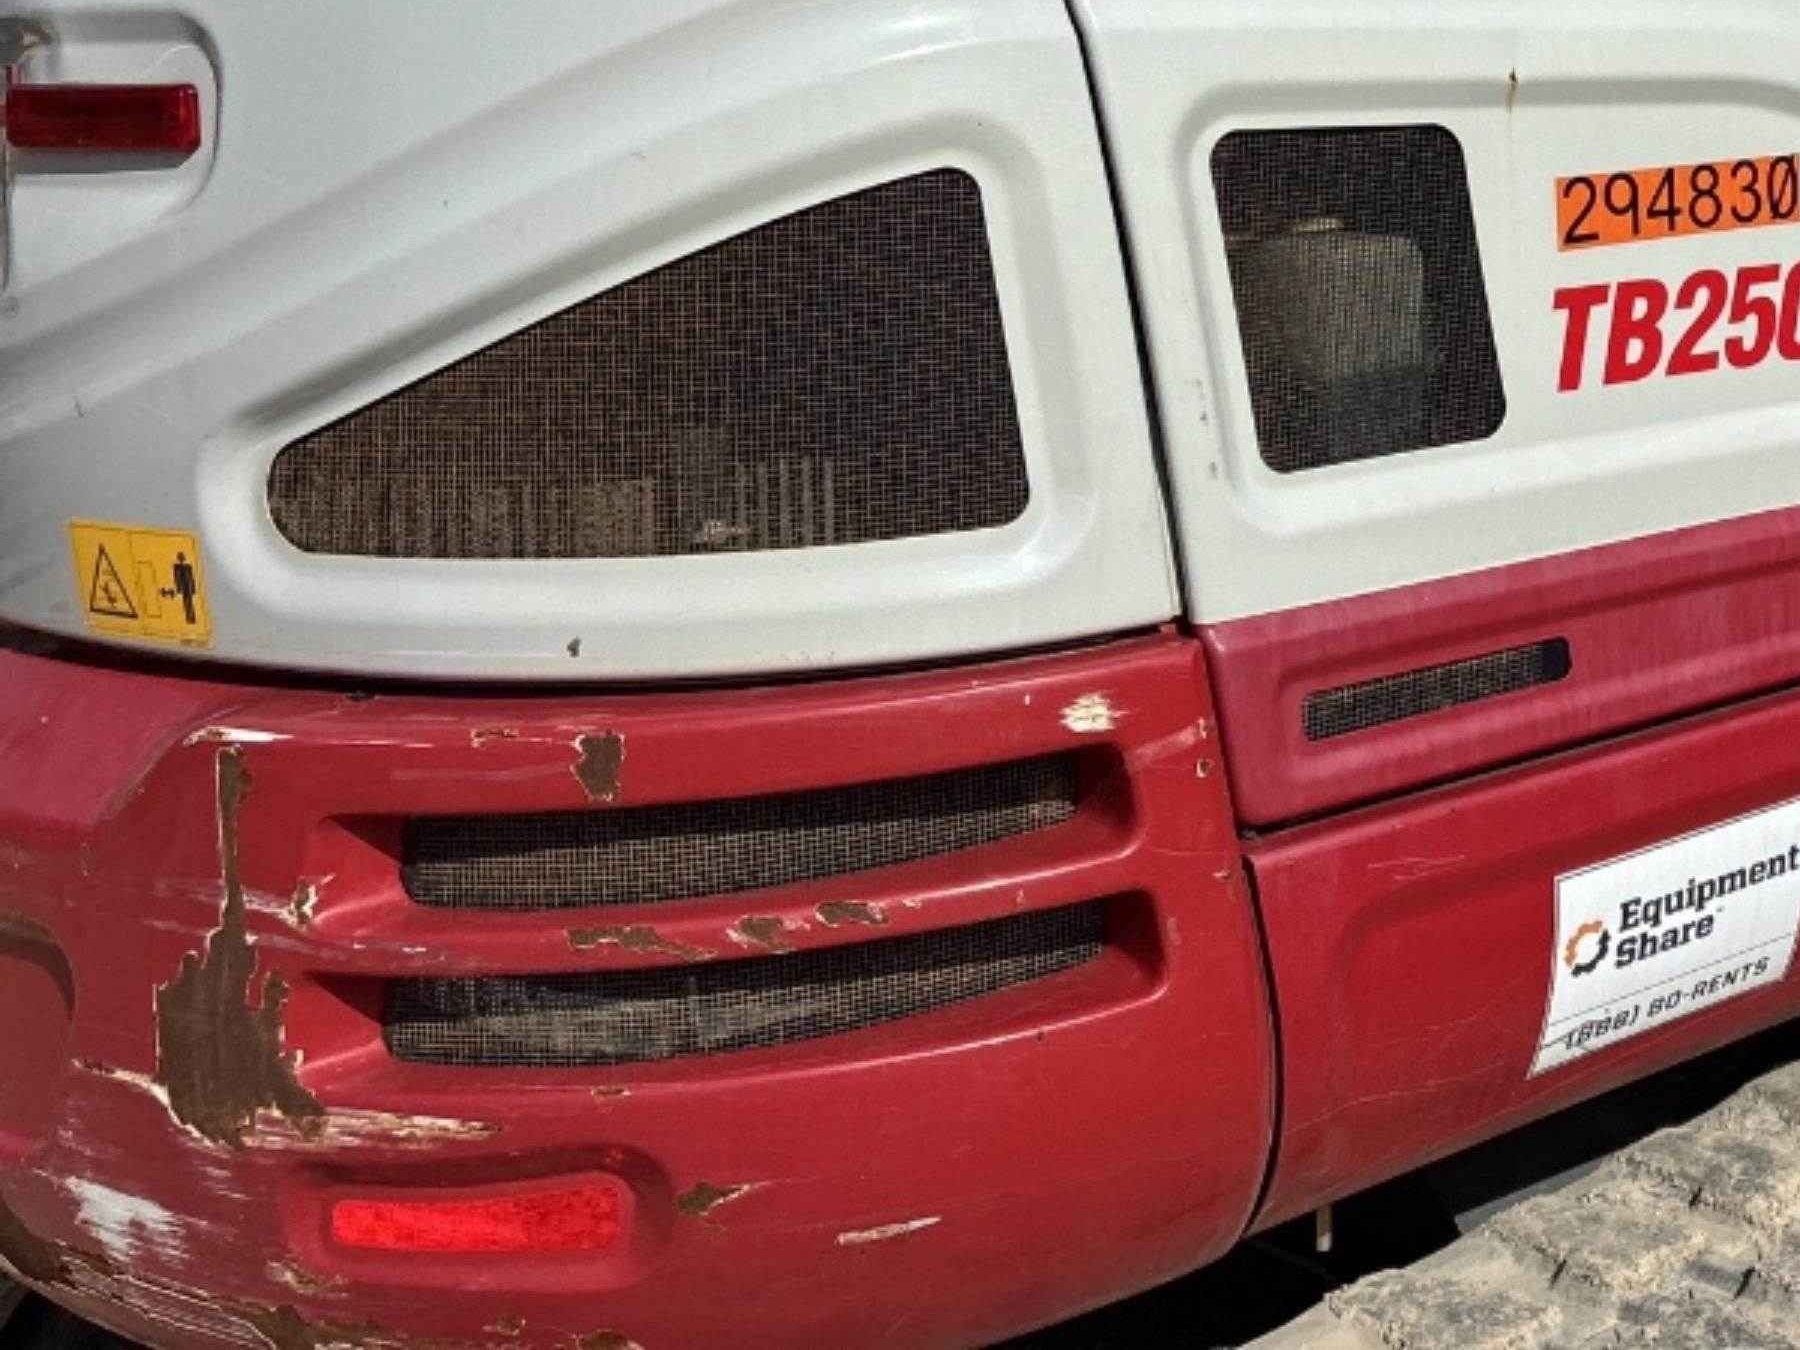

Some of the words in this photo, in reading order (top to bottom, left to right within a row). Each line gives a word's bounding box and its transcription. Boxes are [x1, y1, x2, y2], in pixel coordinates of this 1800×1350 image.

[1562, 154, 1799, 244] 294830
[1619, 844, 1800, 932] Equipment
[1614, 914, 1714, 969] Share
